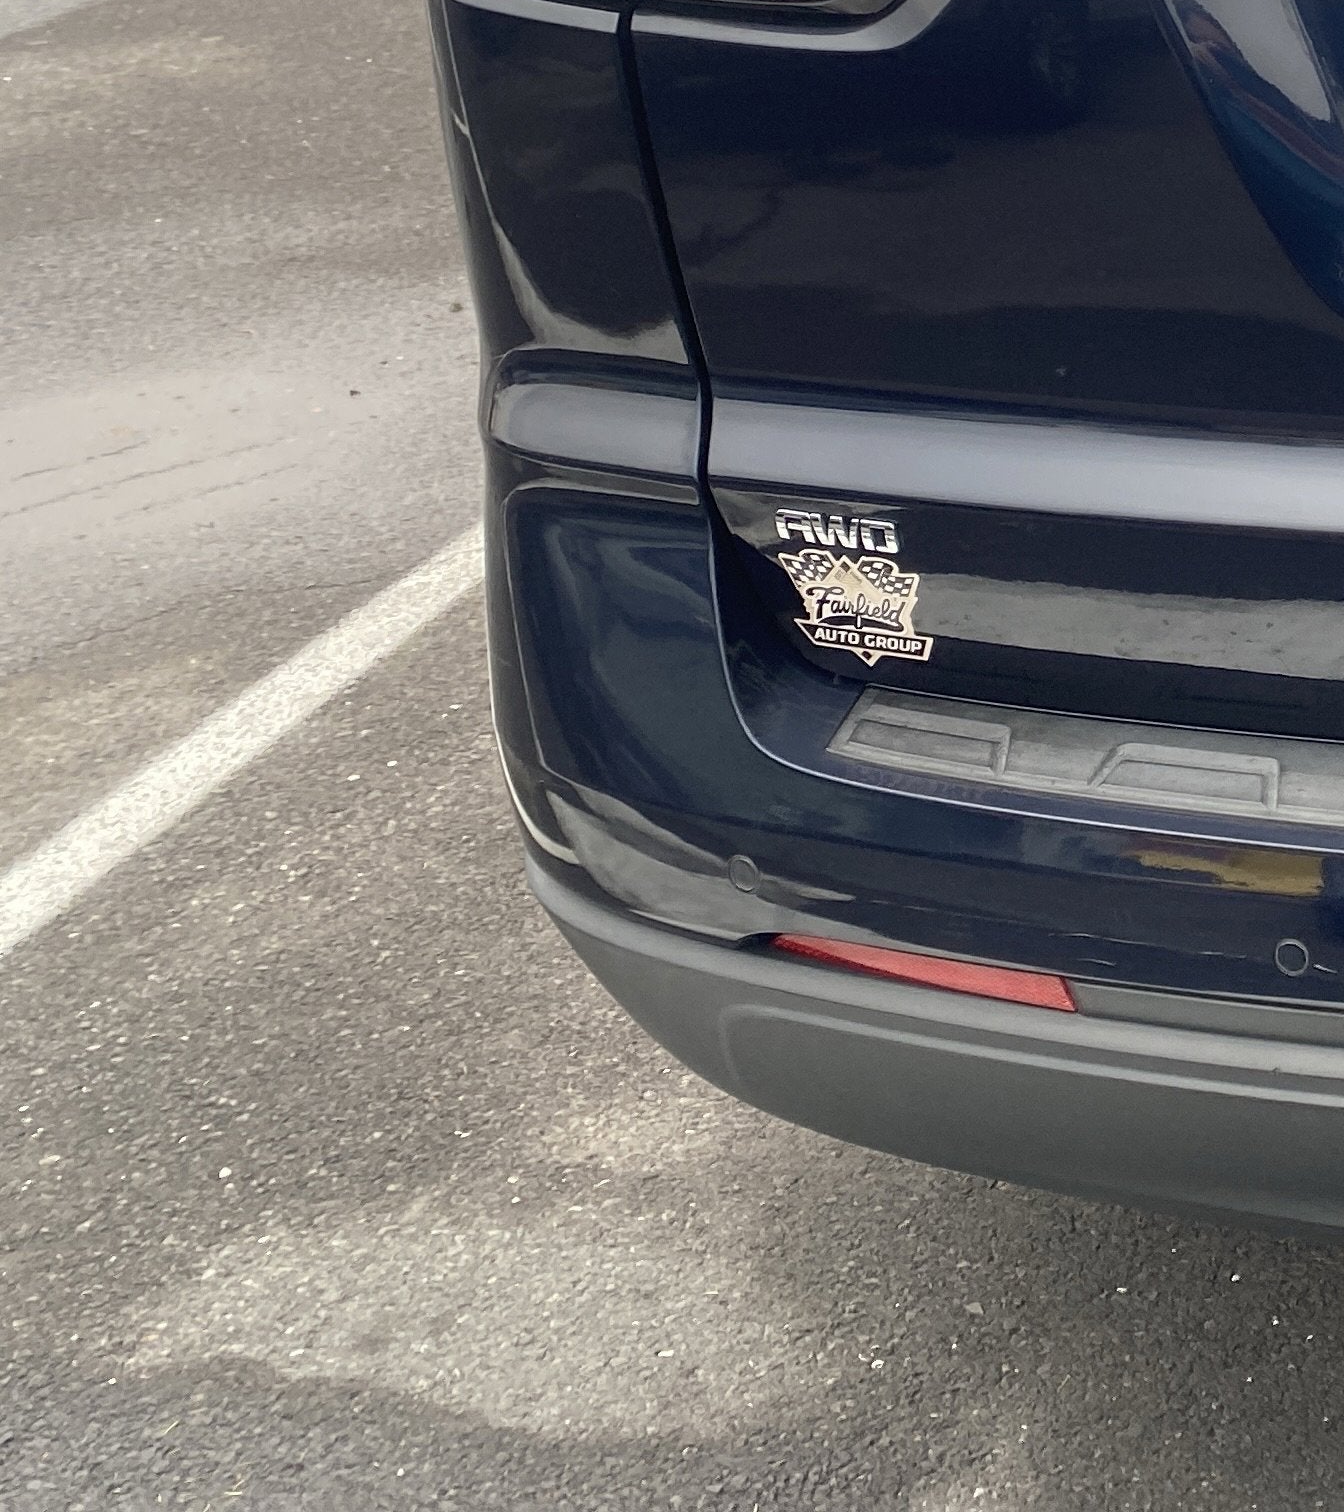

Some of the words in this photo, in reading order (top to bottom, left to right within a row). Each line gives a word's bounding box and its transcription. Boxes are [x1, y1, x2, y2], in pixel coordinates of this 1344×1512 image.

[774, 508, 900, 554] AWD
[805, 586, 906, 626] Fairfield
[814, 627, 860, 646] AUTO
[864, 634, 922, 654] GROUP
